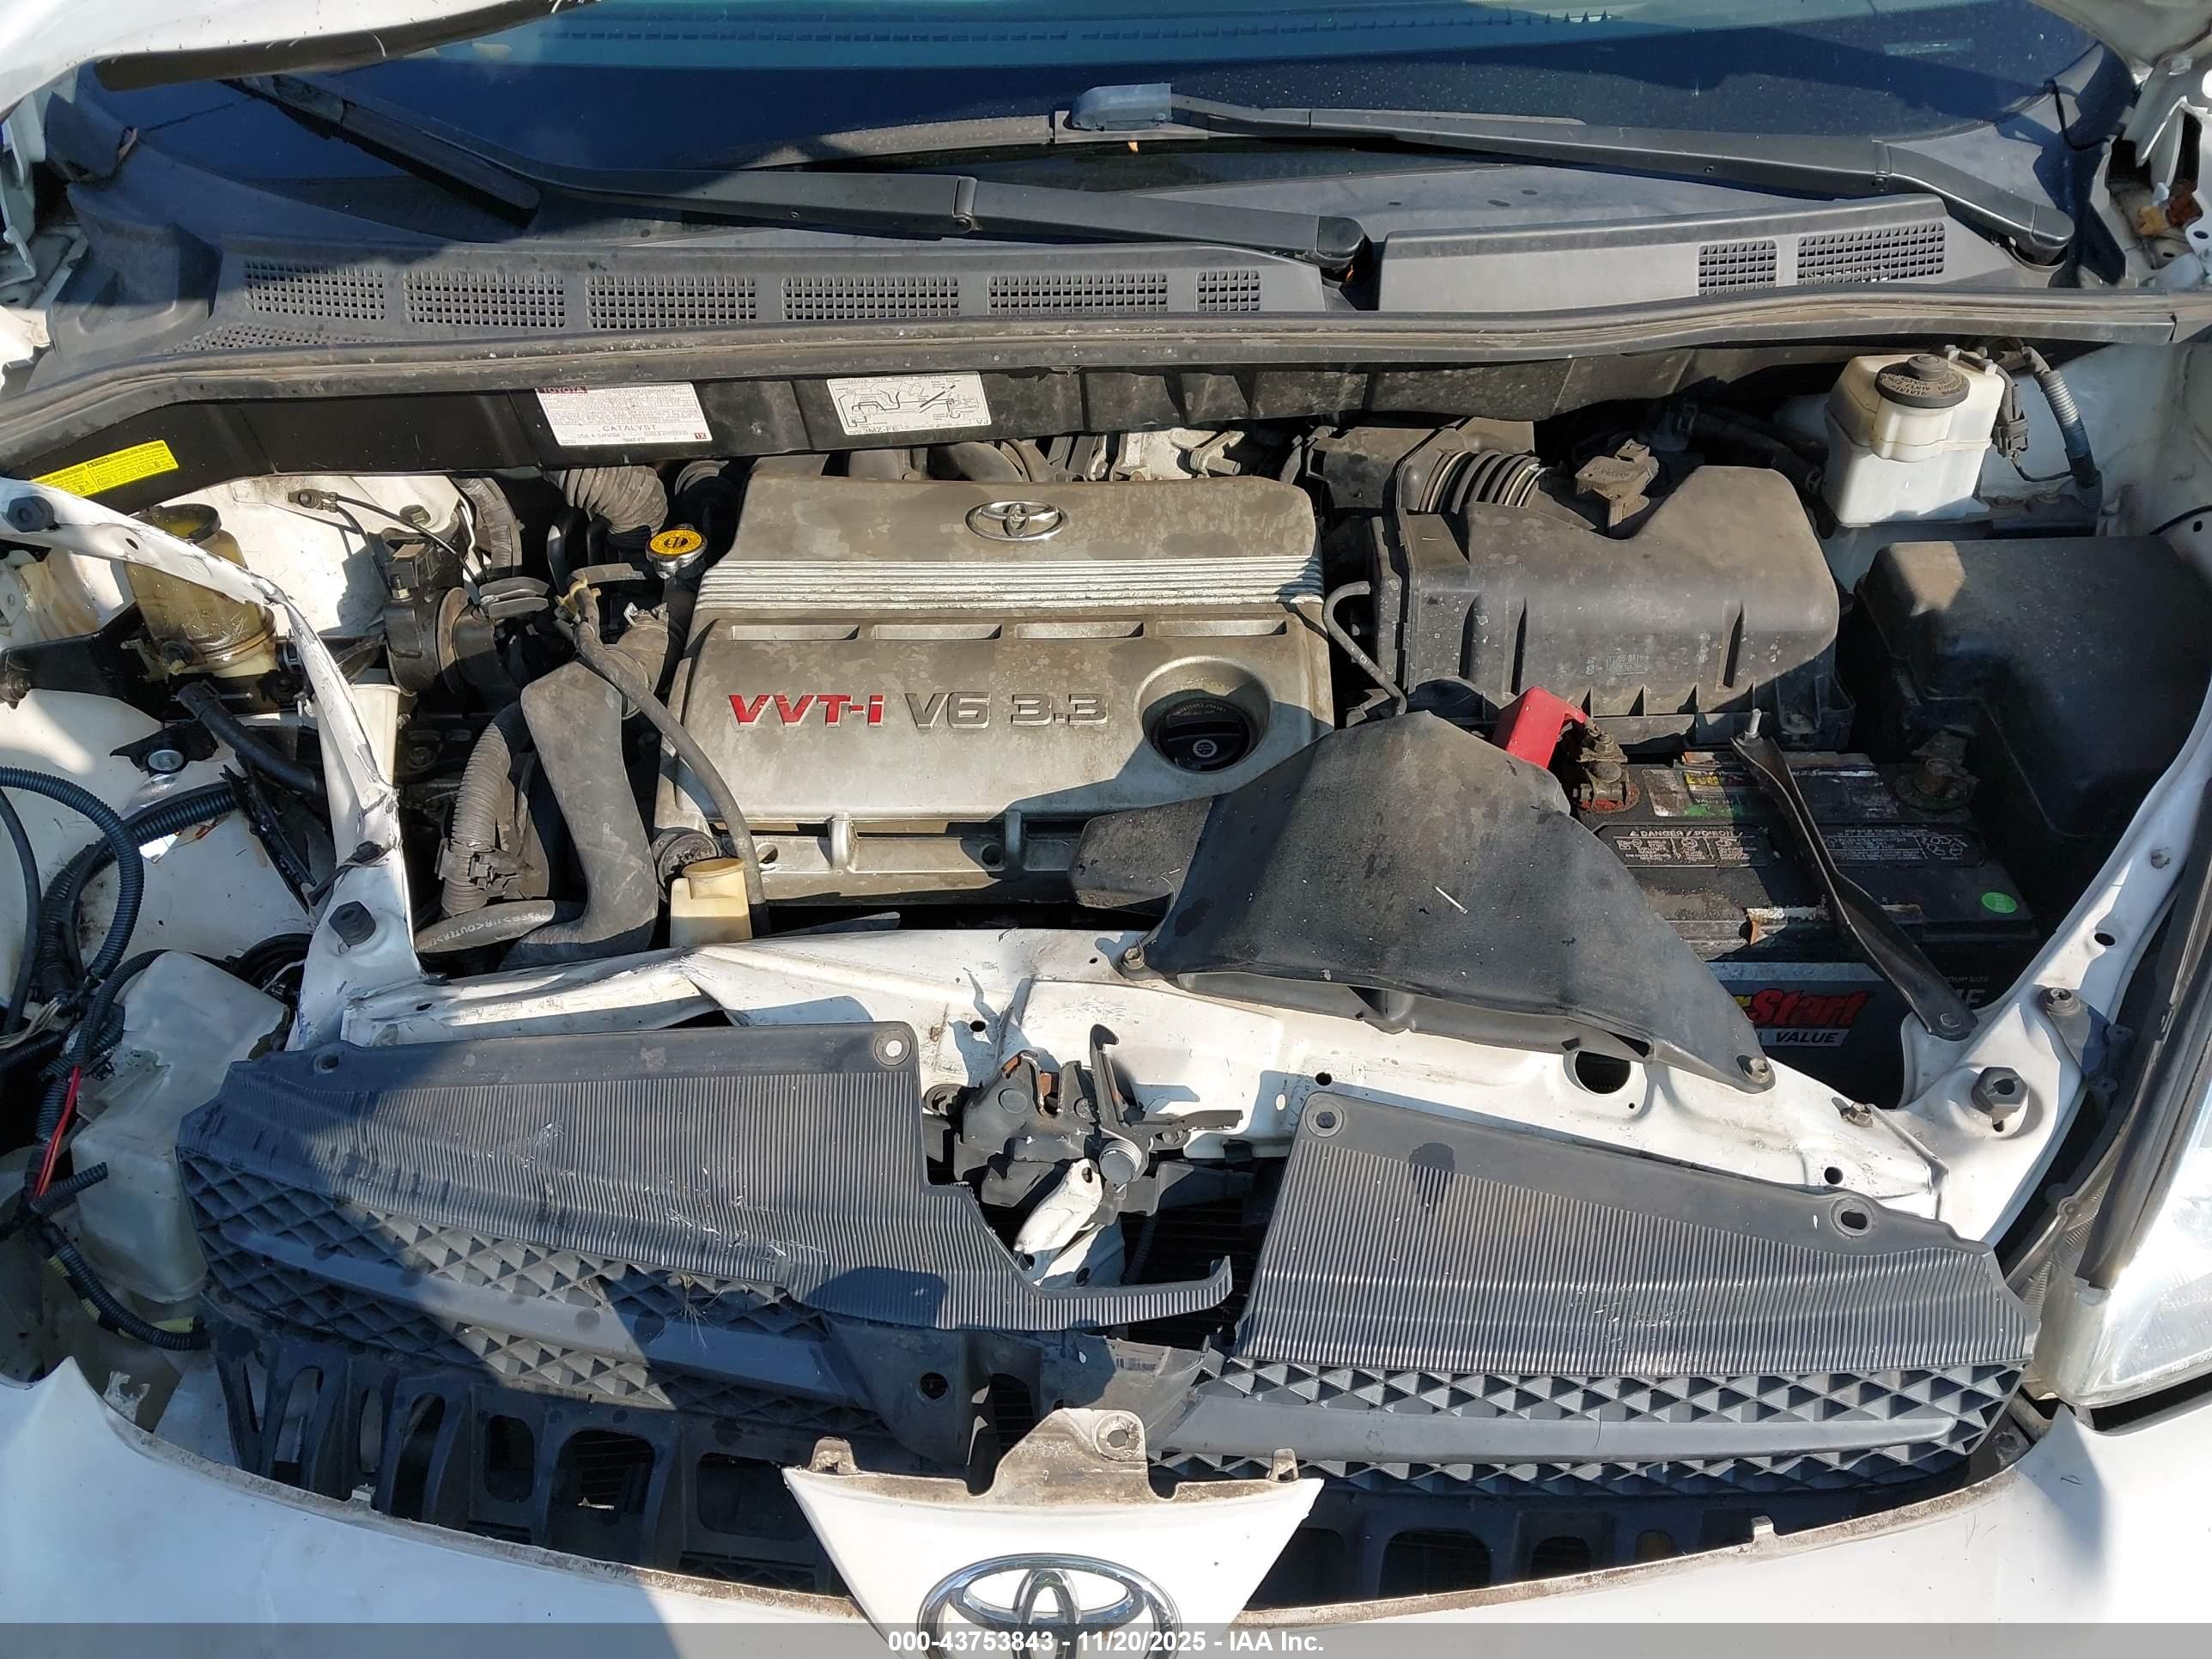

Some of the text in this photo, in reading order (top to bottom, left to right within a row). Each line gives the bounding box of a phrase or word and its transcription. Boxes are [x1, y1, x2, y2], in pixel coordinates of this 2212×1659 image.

[602, 424, 658, 433] CATALYST
[729, 690, 1109, 730] VVT-i V6 3.3
[1775, 1032, 1839, 1044] VALUE
